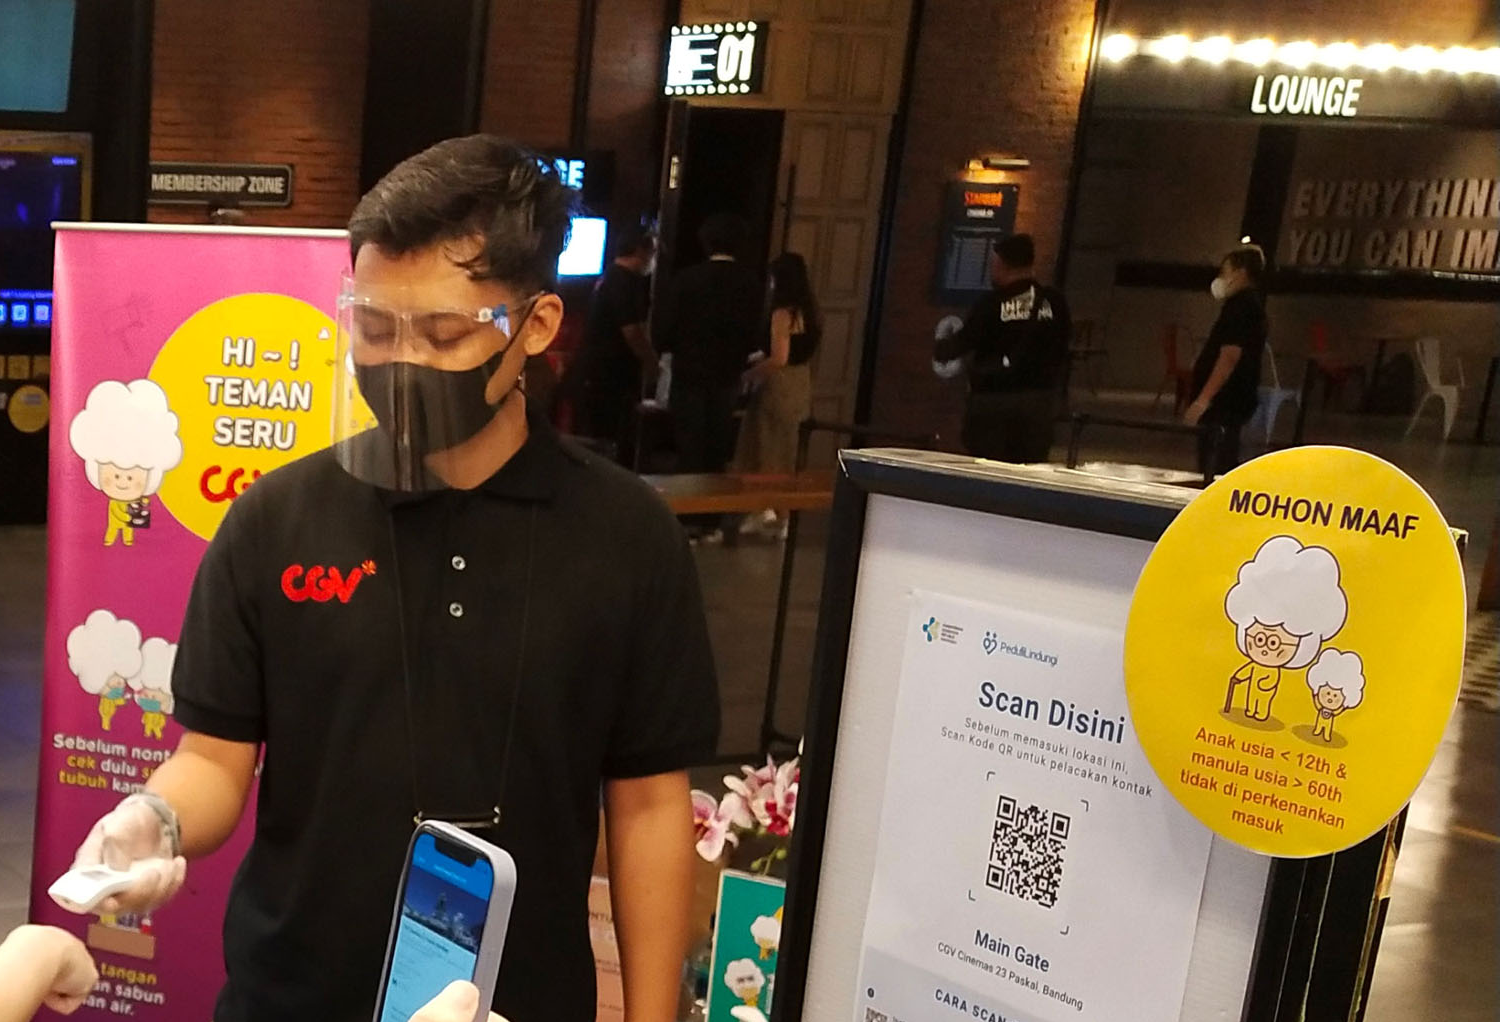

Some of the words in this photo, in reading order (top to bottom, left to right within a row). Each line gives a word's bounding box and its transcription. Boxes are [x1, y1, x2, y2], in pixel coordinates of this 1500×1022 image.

[1251, 75, 1363, 117] LOUNGE
[151, 174, 246, 192] MEMBERSHIP
[248, 176, 285, 194] ZONE
[1288, 229, 1350, 267] YOU
[1365, 229, 1442, 269] CAN
[1450, 229, 1500, 269] IM
[222, 336, 255, 367] HI
[203, 375, 312, 411] TEMAN
[212, 416, 297, 449] SERU
[200, 465, 263, 503] CG
[1229, 488, 1334, 528] MOHON
[1339, 505, 1420, 541] MAAF
[281, 563, 363, 604] CGV
[1000, 642, 1058, 667] PeduliLindungi
[978, 681, 1040, 721] Scan
[1048, 699, 1125, 744] Disini
[53, 733, 127, 757] Sebelum
[130, 747, 172, 763] nont
[965, 717, 1010, 739] Sebelum
[1013, 732, 1069, 757] memasuki
[1073, 748, 1107, 767] lokasi
[1195, 727, 1236, 750] Anak
[1241, 740, 1275, 760] usia
[1297, 753, 1331, 775] 12th
[1336, 763, 1347, 780] &
[59, 769, 107, 789] tubuh
[112, 777, 146, 794] kam
[67, 755, 96, 769] cek
[101, 758, 136, 777] dulu
[941, 727, 965, 742] Scan
[969, 736, 995, 751] Kode
[998, 743, 1013, 756] QR
[1017, 748, 1046, 766] untuk
[1050, 758, 1108, 785] pelacakan
[1112, 775, 1153, 798] kontak
[1191, 752, 1249, 777] manula
[1254, 768, 1288, 788] usia
[1307, 780, 1343, 803] 60th
[1180, 768, 1218, 792] tidak
[1223, 782, 1238, 797] di
[1241, 789, 1345, 830] perkenankan
[1231, 810, 1284, 835] masuk
[974, 929, 1010, 957] Main
[1014, 946, 1050, 972] Gate
[101, 962, 157, 985] tangan
[938, 942, 957, 957] CGV
[957, 950, 993, 973] Cinemas
[995, 965, 1007, 978] 23
[1042, 984, 1083, 1012] Bandung
[115, 984, 165, 1005] sabun
[935, 989, 967, 1012] CARA
